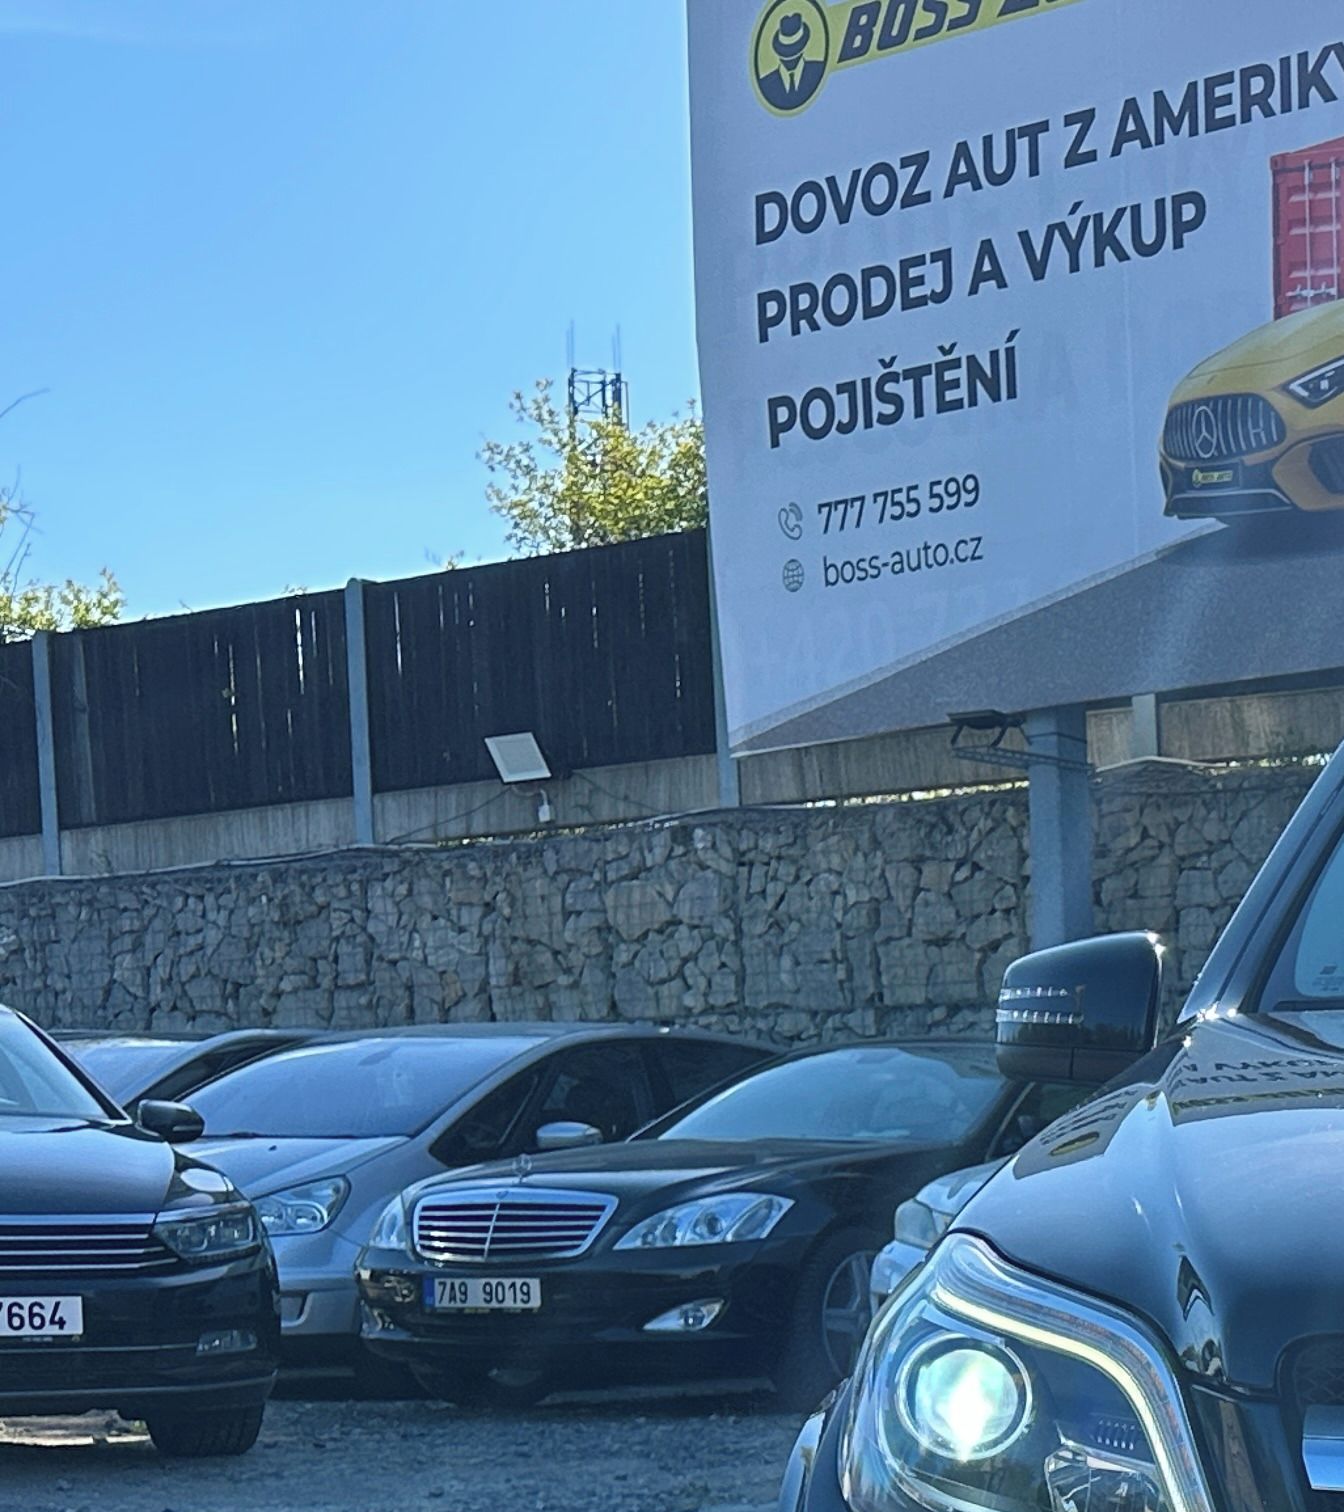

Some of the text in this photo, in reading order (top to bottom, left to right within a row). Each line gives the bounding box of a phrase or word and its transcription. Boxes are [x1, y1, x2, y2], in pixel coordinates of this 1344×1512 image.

[837, 0, 982, 64] BOSS
[755, 150, 932, 246] DOVOZ
[943, 119, 1050, 199] AUT
[1063, 107, 1098, 169] Z
[757, 190, 1207, 343] PRODEJ A VÝKUP
[767, 328, 1021, 449] POJIŠTĚNÍ
[817, 473, 980, 535] 777 755 599
[823, 536, 984, 588] boss-auto.cz
[0, 1301, 66, 1332] 664
[438, 1281, 531, 1305] 7A9 9019
